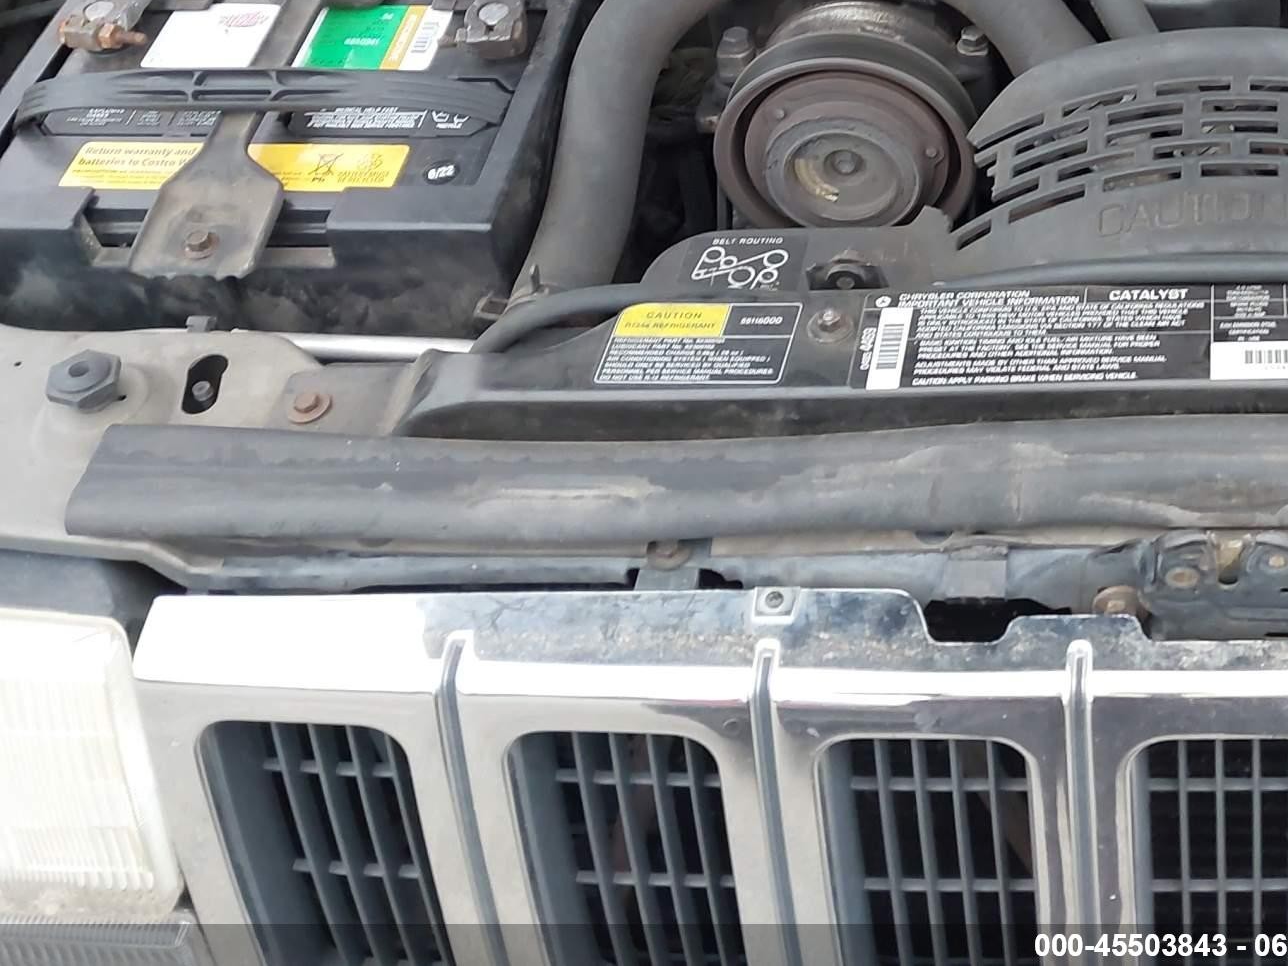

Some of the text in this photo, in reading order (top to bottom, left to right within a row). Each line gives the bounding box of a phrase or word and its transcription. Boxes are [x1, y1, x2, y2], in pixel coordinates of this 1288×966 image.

[84, 146, 198, 157] Return warranty and
[78, 158, 126, 166] batteries
[128, 158, 139, 166] to
[1099, 191, 1288, 237] CAUTION
[712, 237, 784, 245] BELT ROUTING
[899, 289, 1030, 301] CHRYSLER CORPORATION
[1109, 288, 1188, 300] CATALYST
[898, 295, 1080, 308] IMPORTANT VEHICLE INFORMATION
[646, 312, 703, 320] CAUTION
[652, 321, 716, 329] REFRIGERANT
